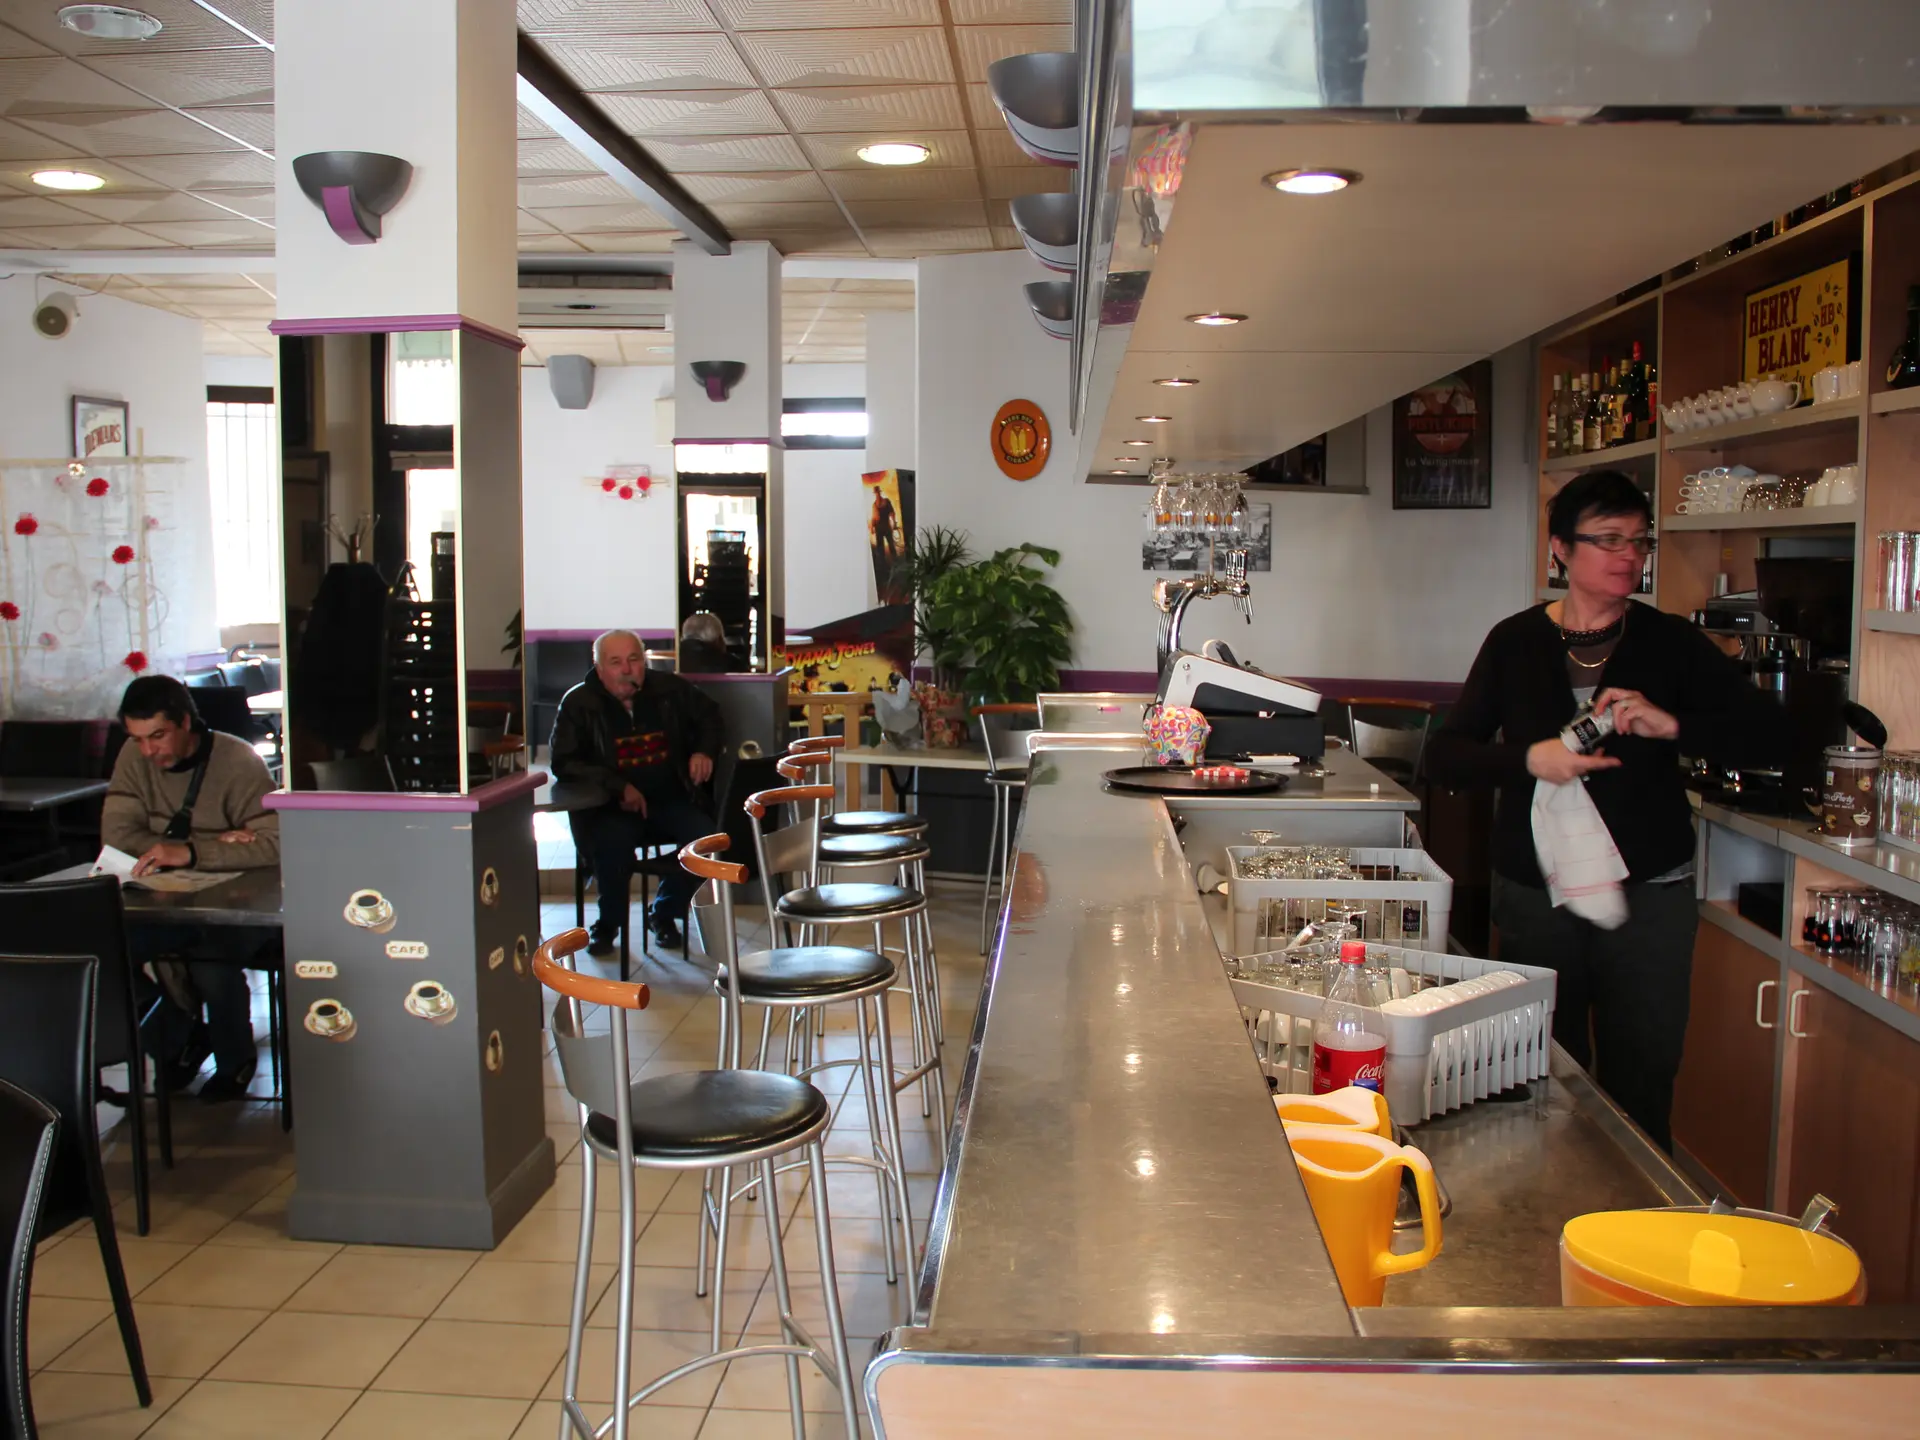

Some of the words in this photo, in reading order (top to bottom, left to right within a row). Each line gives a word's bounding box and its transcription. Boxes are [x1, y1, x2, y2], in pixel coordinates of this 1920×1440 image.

[1749, 285, 1802, 338] HENRY
[1821, 302, 1835, 328] HB
[1758, 324, 1811, 374] BLANC
[828, 641, 877, 670] JONES
[298, 964, 334, 975] CAFE
